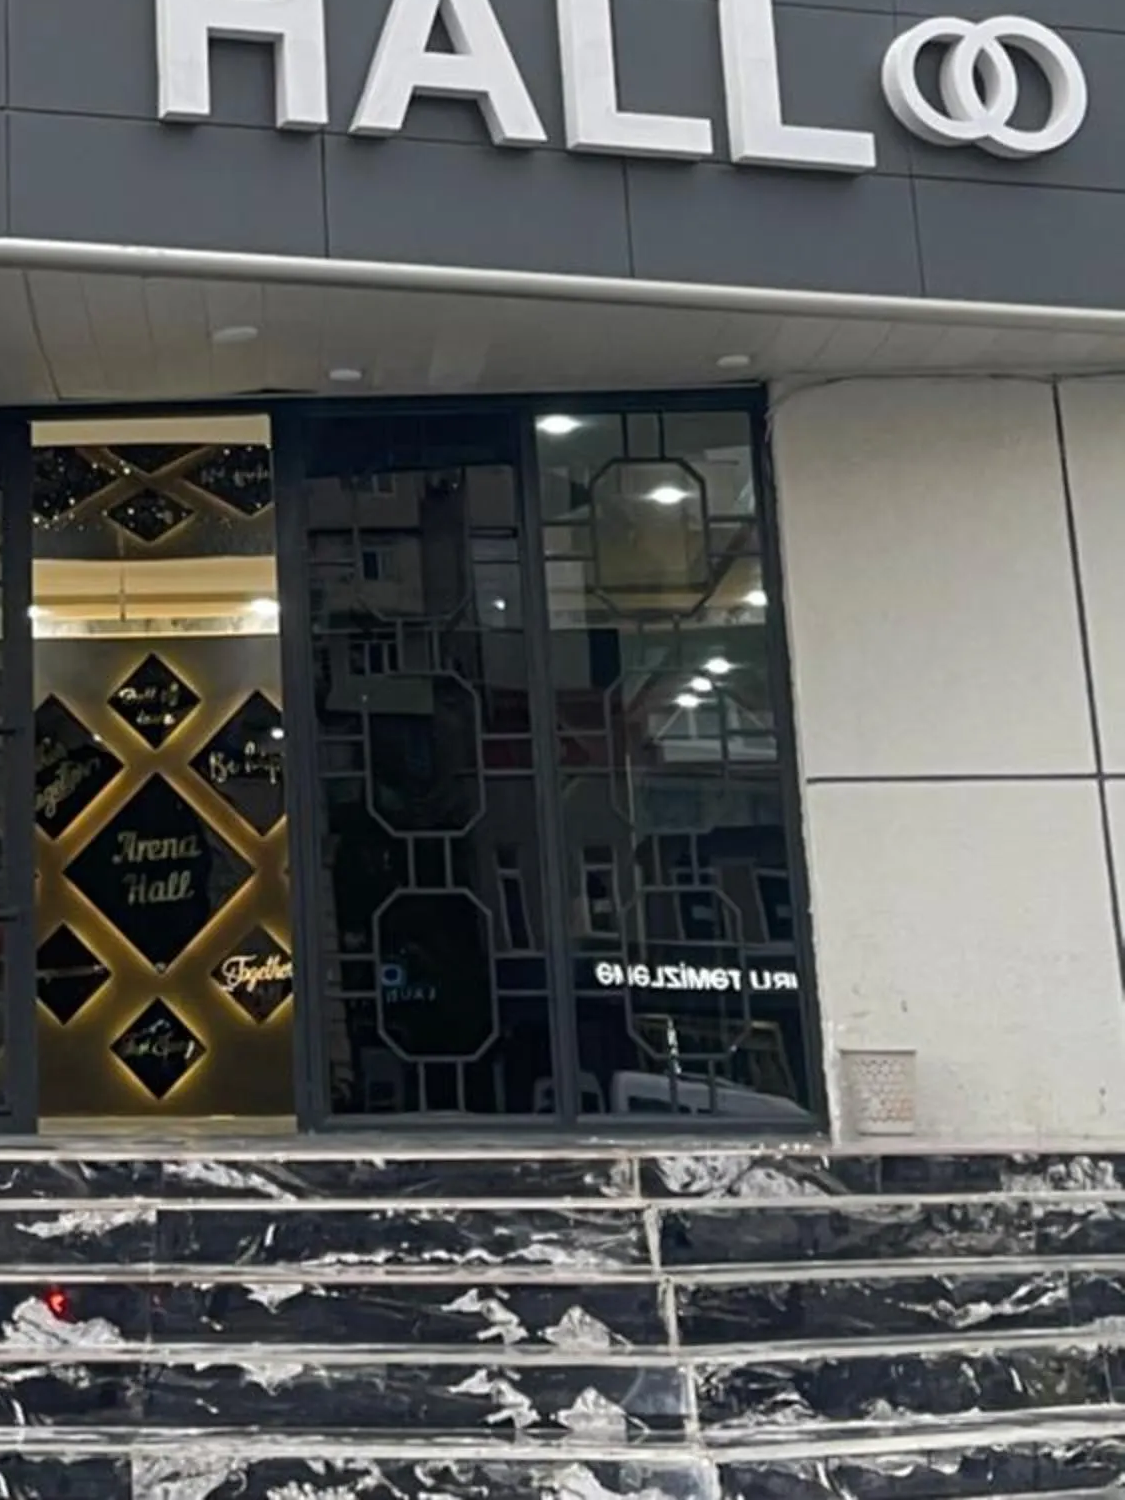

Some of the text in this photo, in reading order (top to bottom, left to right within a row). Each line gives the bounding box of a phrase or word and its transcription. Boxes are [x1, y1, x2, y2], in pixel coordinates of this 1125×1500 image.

[112, 831, 203, 864] Arena
[121, 869, 195, 906] Hall
[220, 954, 293, 992] Togethe
